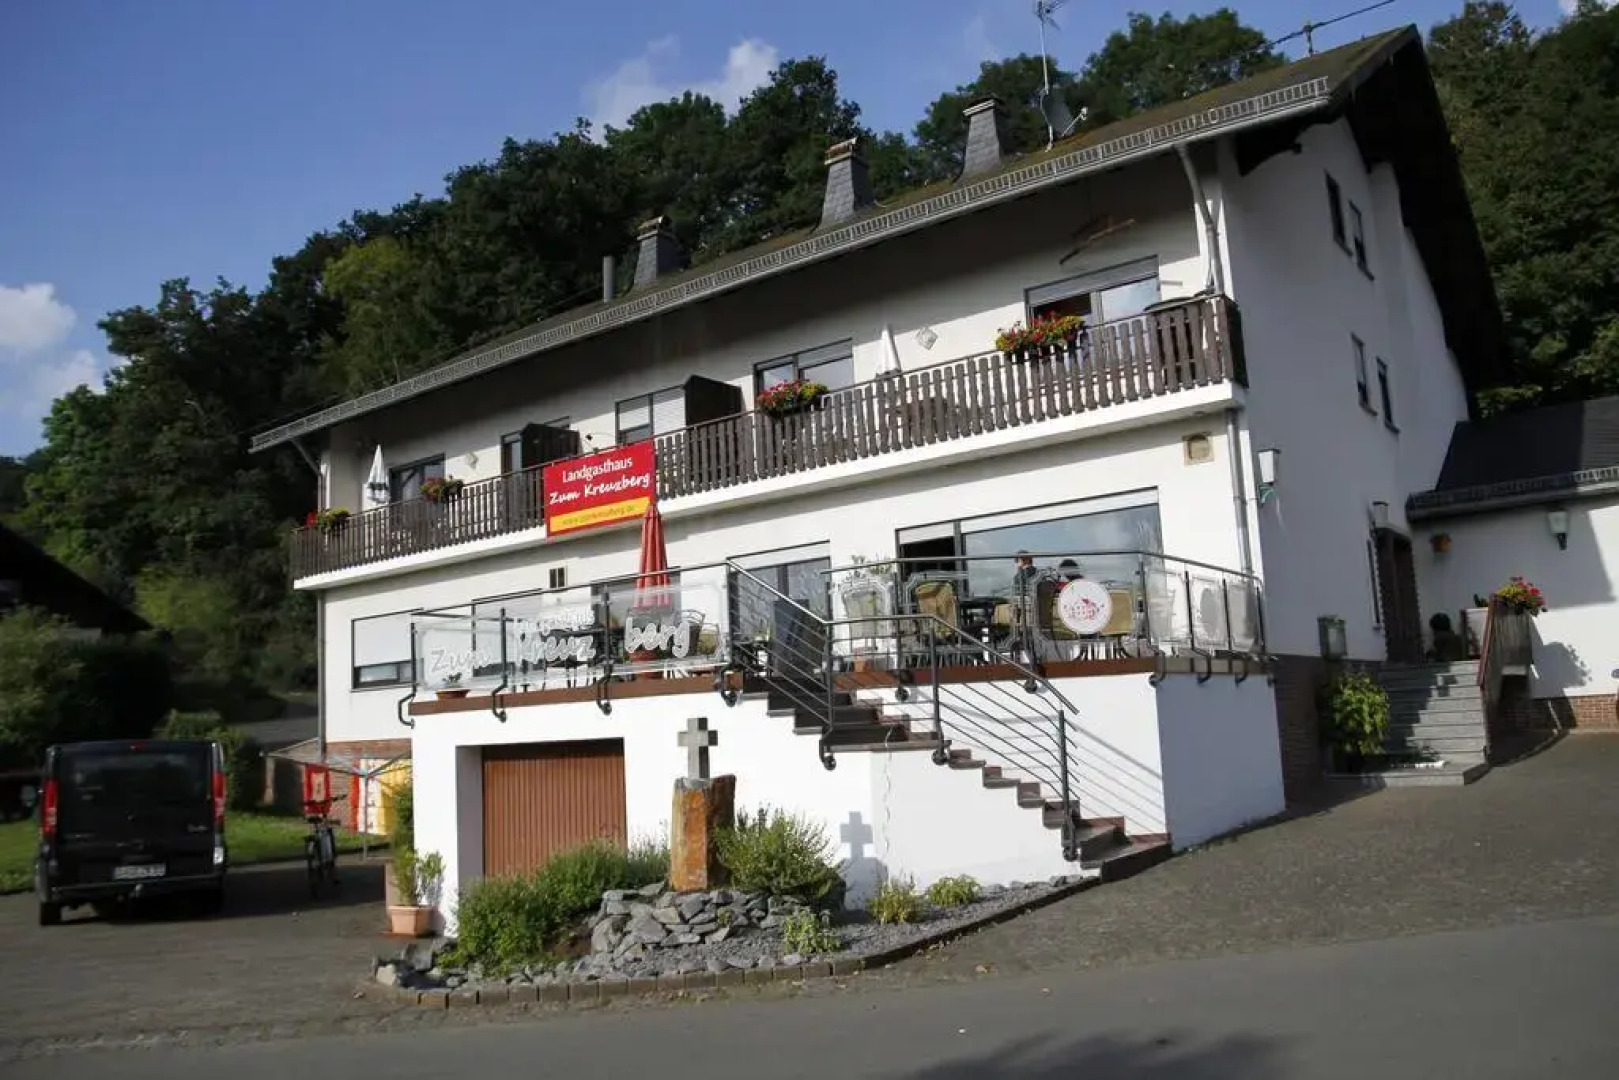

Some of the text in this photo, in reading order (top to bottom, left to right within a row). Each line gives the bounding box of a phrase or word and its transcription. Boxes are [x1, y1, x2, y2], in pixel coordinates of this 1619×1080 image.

[562, 457, 633, 483] Landgasthaus
[549, 472, 651, 505] Zum Kreuzberg
[624, 617, 691, 659] berg
